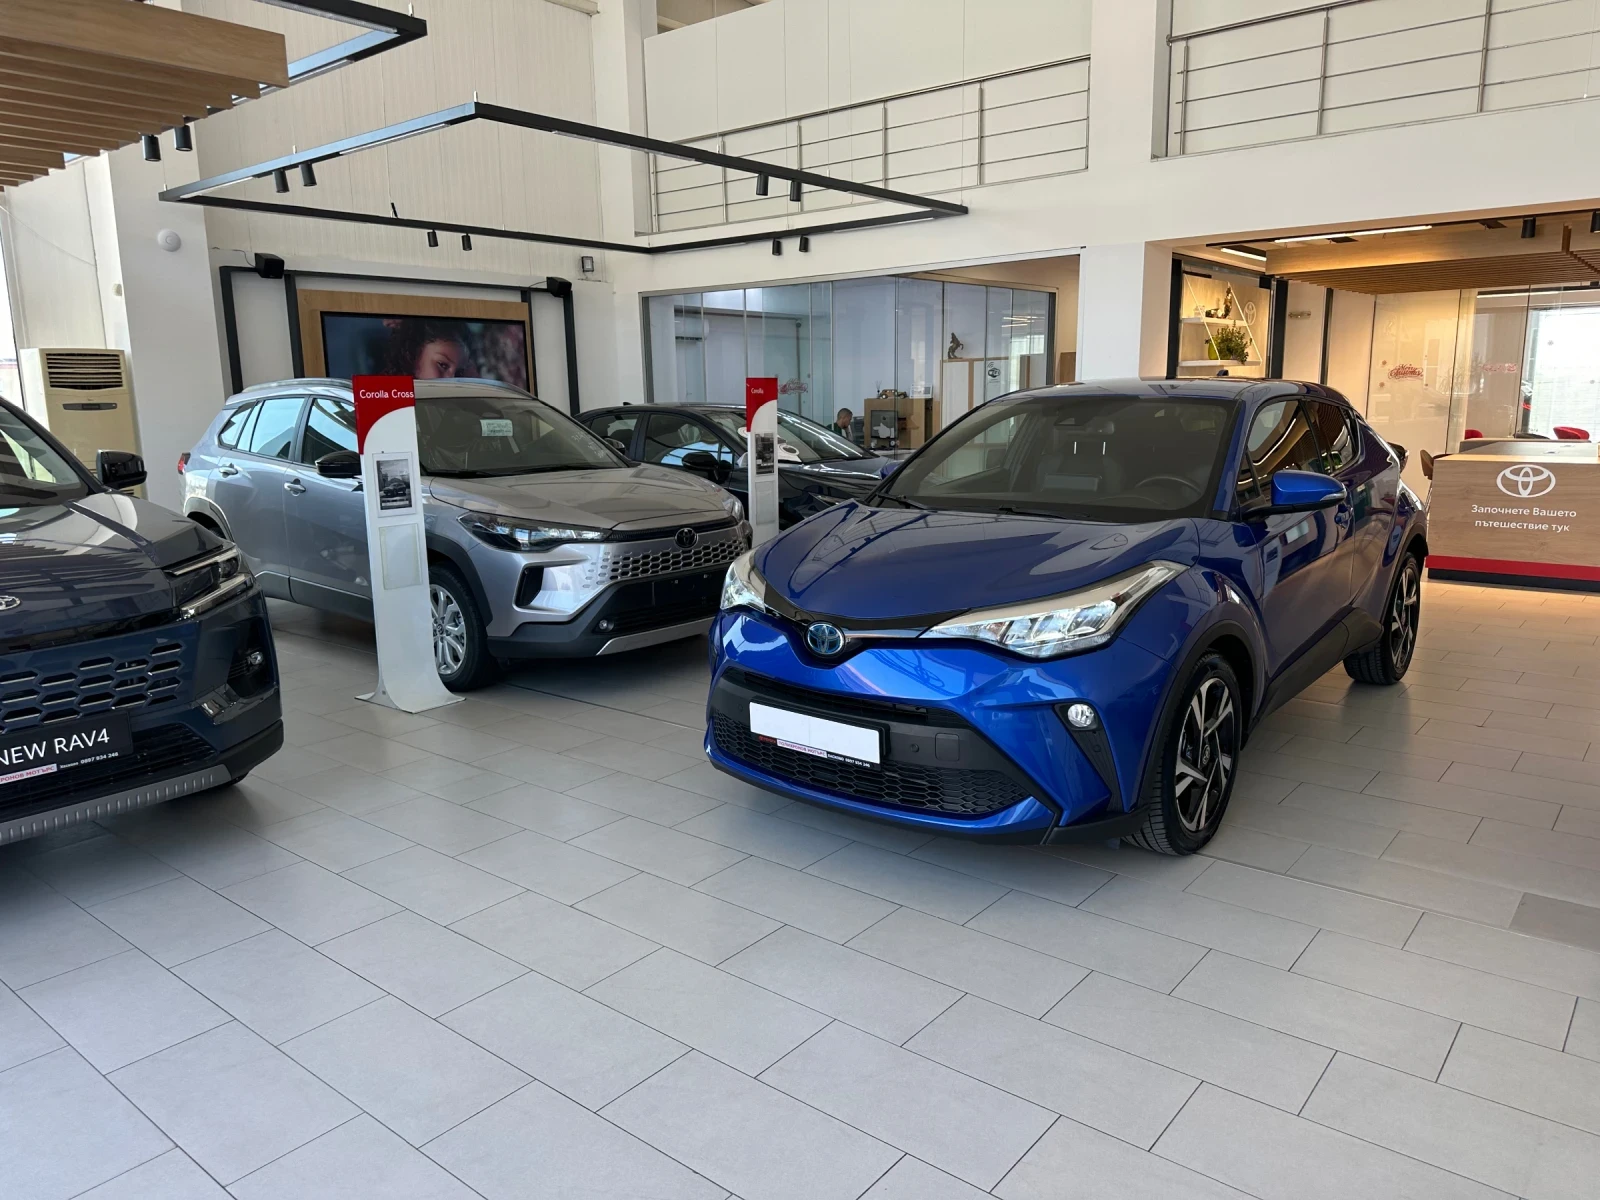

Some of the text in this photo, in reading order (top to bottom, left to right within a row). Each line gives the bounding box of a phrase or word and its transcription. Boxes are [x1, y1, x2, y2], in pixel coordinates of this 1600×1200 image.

[359, 389, 414, 399] Corolla Cross
[1471, 504, 1577, 518] Започнете Вашето
[1474, 520, 1570, 533] пътешествие тук
[54, 728, 110, 754] RAV4
[26, 765, 55, 777] МОТЪРС
